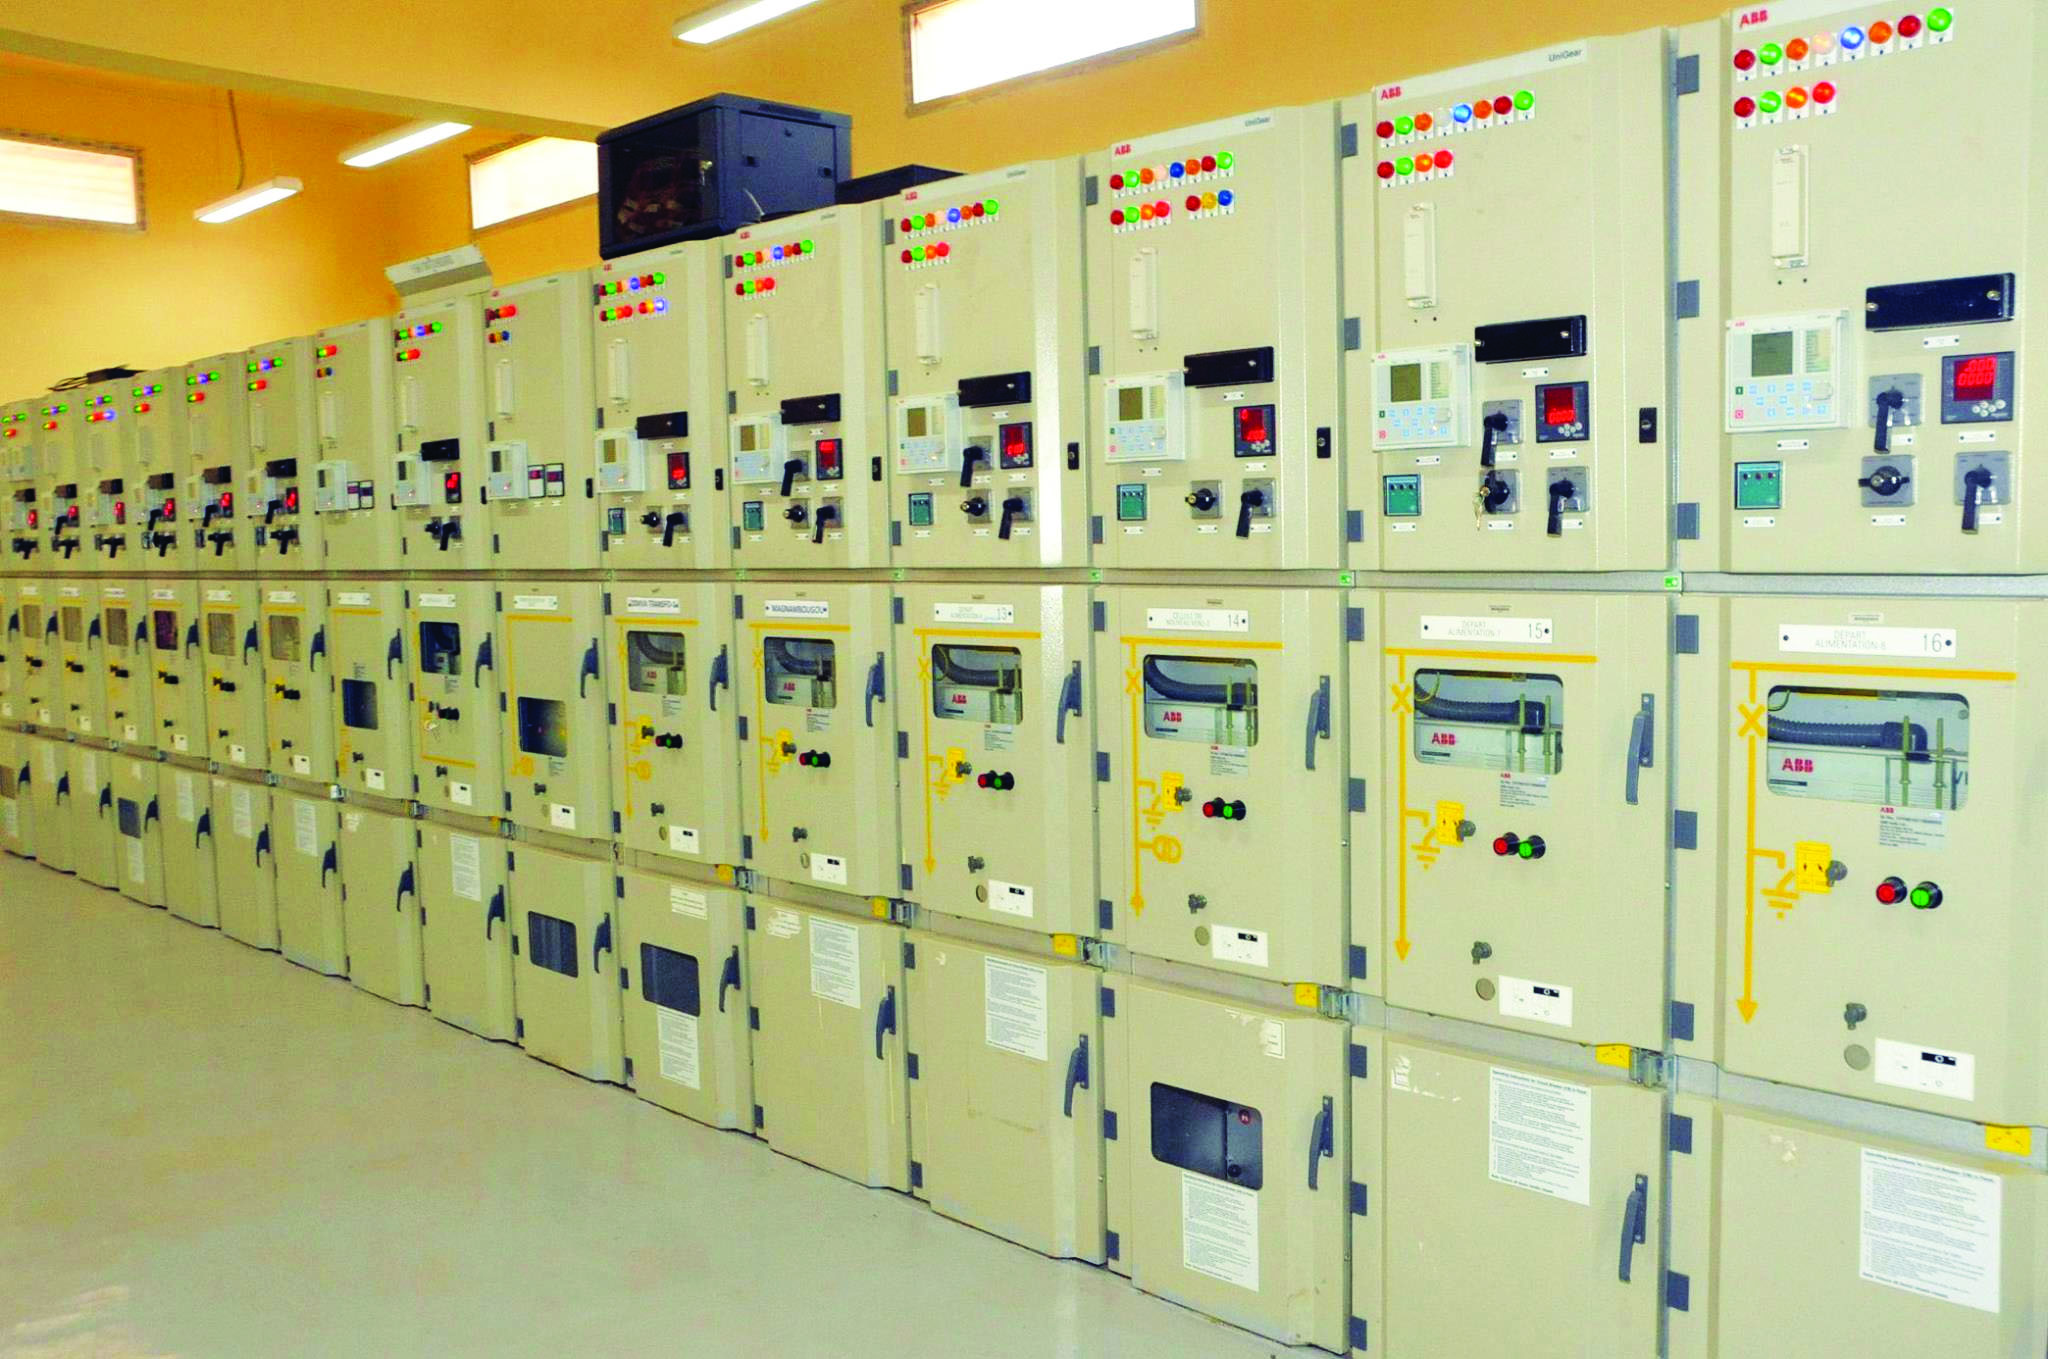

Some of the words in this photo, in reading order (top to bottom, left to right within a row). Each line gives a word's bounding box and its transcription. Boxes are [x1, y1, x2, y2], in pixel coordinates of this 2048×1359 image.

[1739, 10, 1768, 28] ABB
[1381, 86, 1402, 100] ABB
[1115, 144, 1131, 156] ABB
[1227, 613, 1240, 628] 14
[1528, 622, 1543, 640] 15
[1922, 632, 1943, 653] 16
[952, 693, 967, 705] ABB
[1163, 711, 1182, 723] ABB
[1431, 732, 1456, 745] ABB
[1782, 757, 1814, 774] ABB
